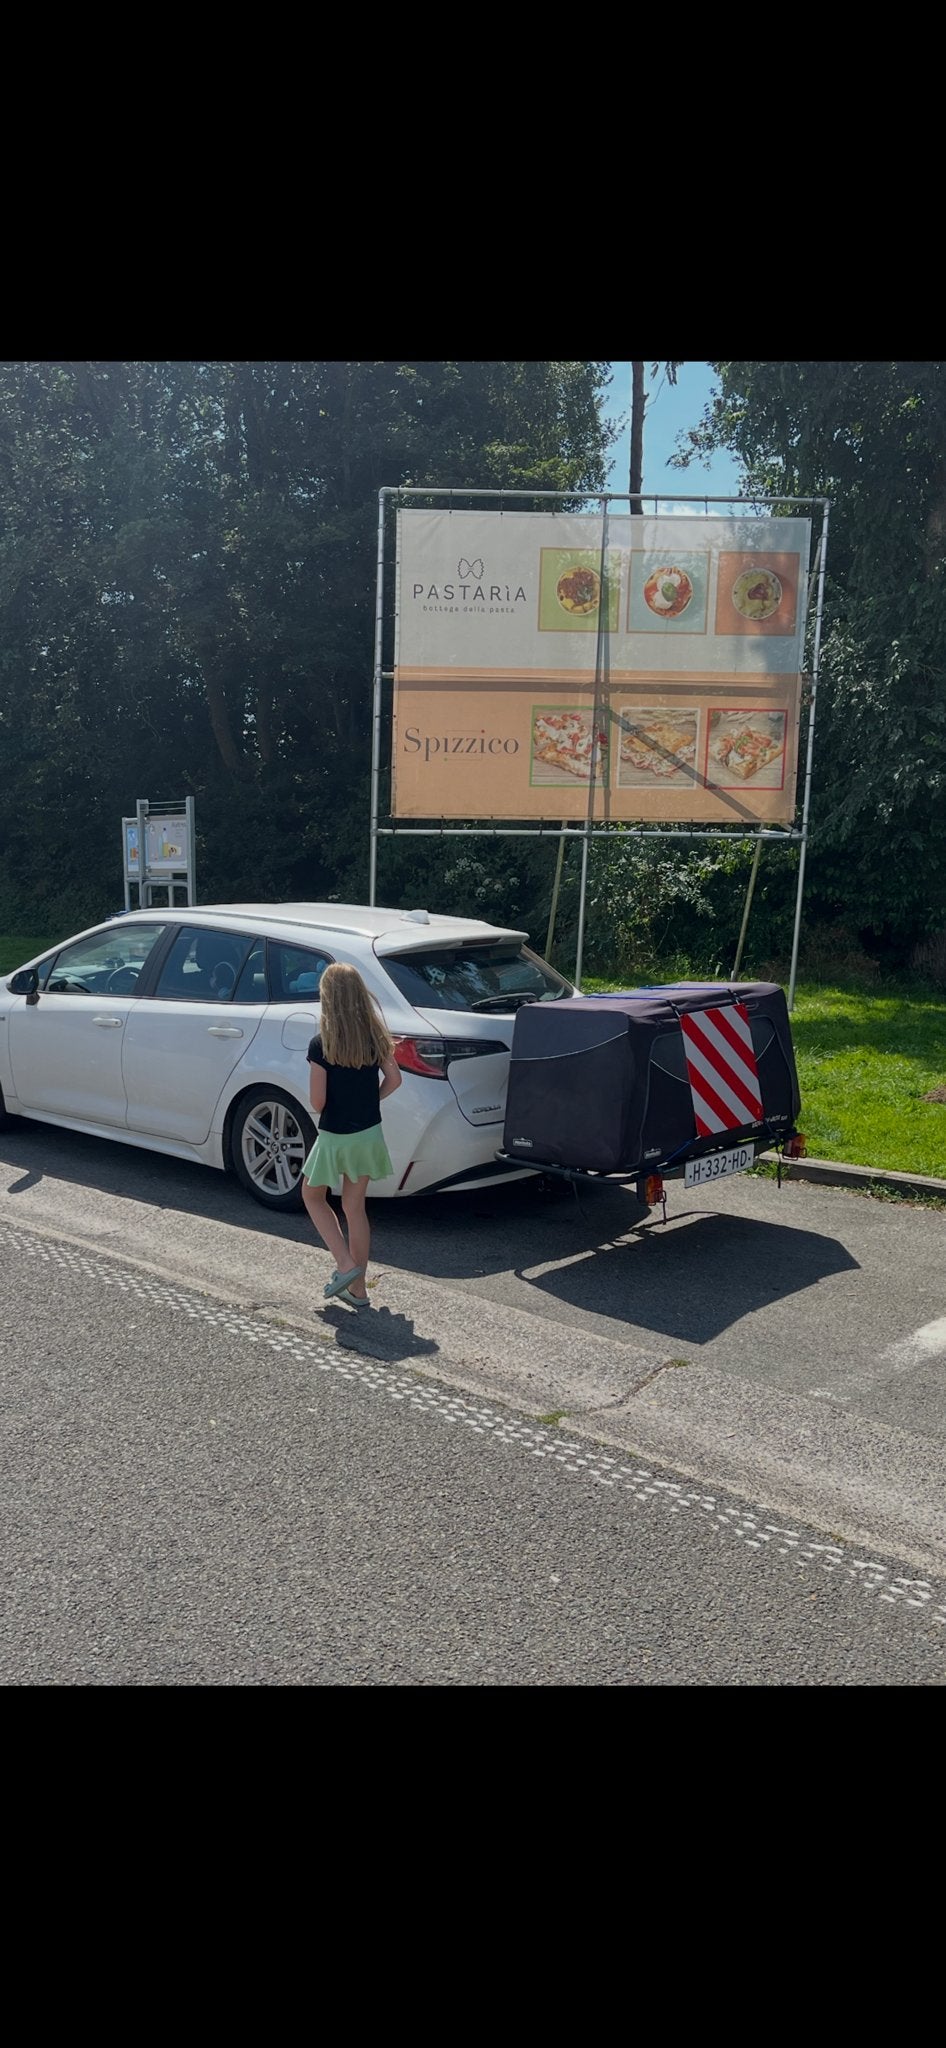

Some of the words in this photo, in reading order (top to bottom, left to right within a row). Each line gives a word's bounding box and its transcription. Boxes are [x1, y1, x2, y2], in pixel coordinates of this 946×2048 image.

[423, 605, 459, 613] bottega
[463, 605, 486, 613] della
[403, 727, 519, 762] Spizzico
